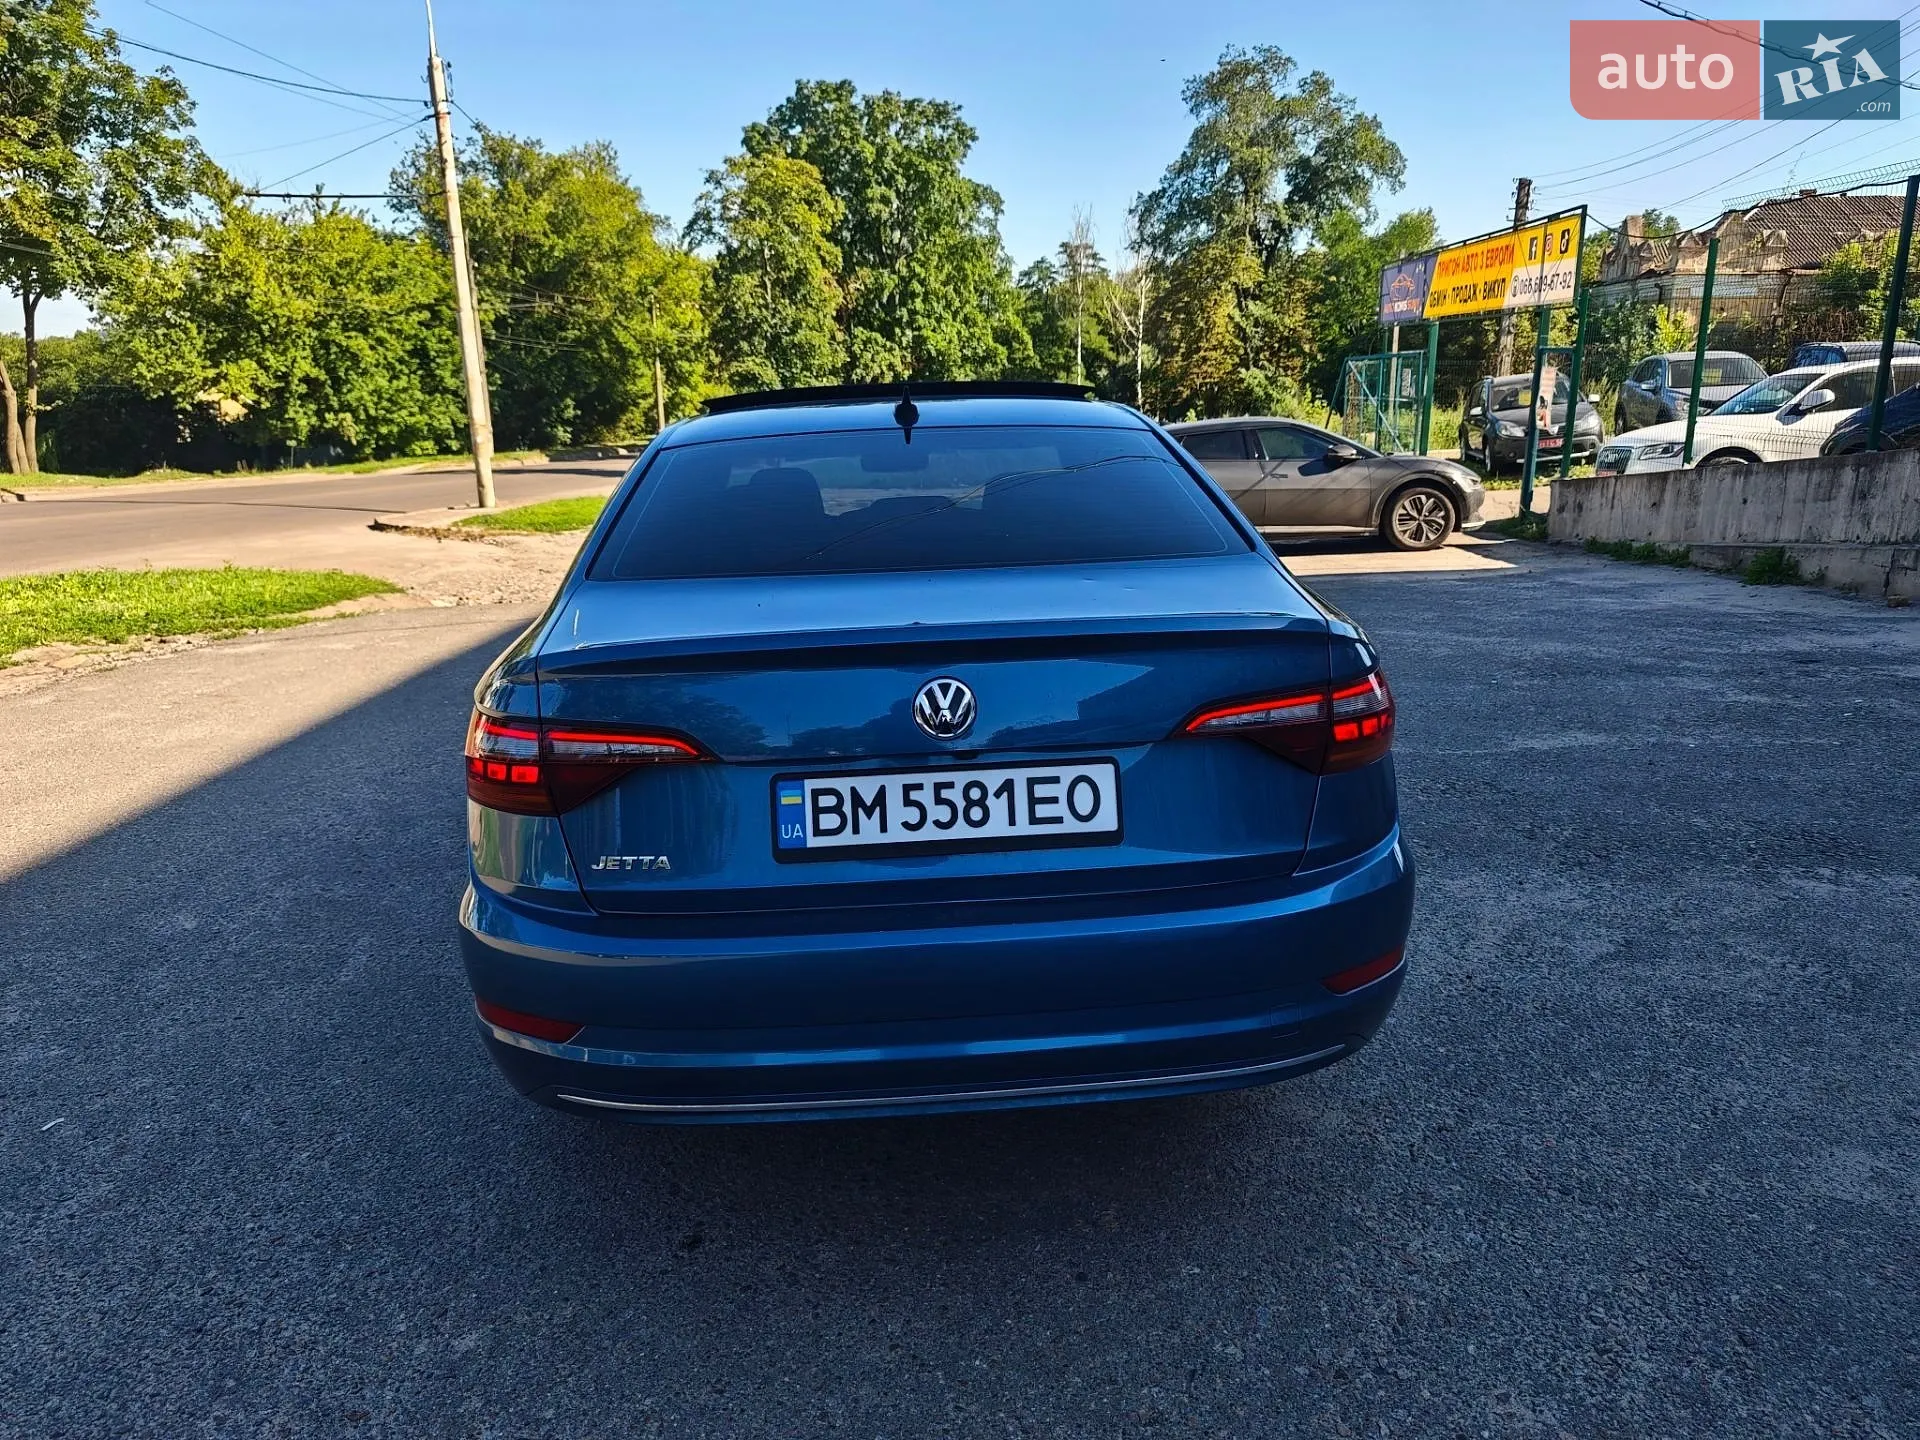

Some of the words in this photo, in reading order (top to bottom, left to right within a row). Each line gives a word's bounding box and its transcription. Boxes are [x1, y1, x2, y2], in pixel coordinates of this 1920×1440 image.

[1437, 257, 1461, 277] ПРИГОН
[1461, 251, 1479, 273] АВТО
[1485, 243, 1515, 269] ЕВРОПИ
[1429, 289, 1448, 309] ОБМІН
[1450, 282, 1479, 305] ПРОДАЖ
[1482, 276, 1507, 301] ВИКУП
[781, 823, 804, 839] UA
[591, 855, 671, 870] JETTA
